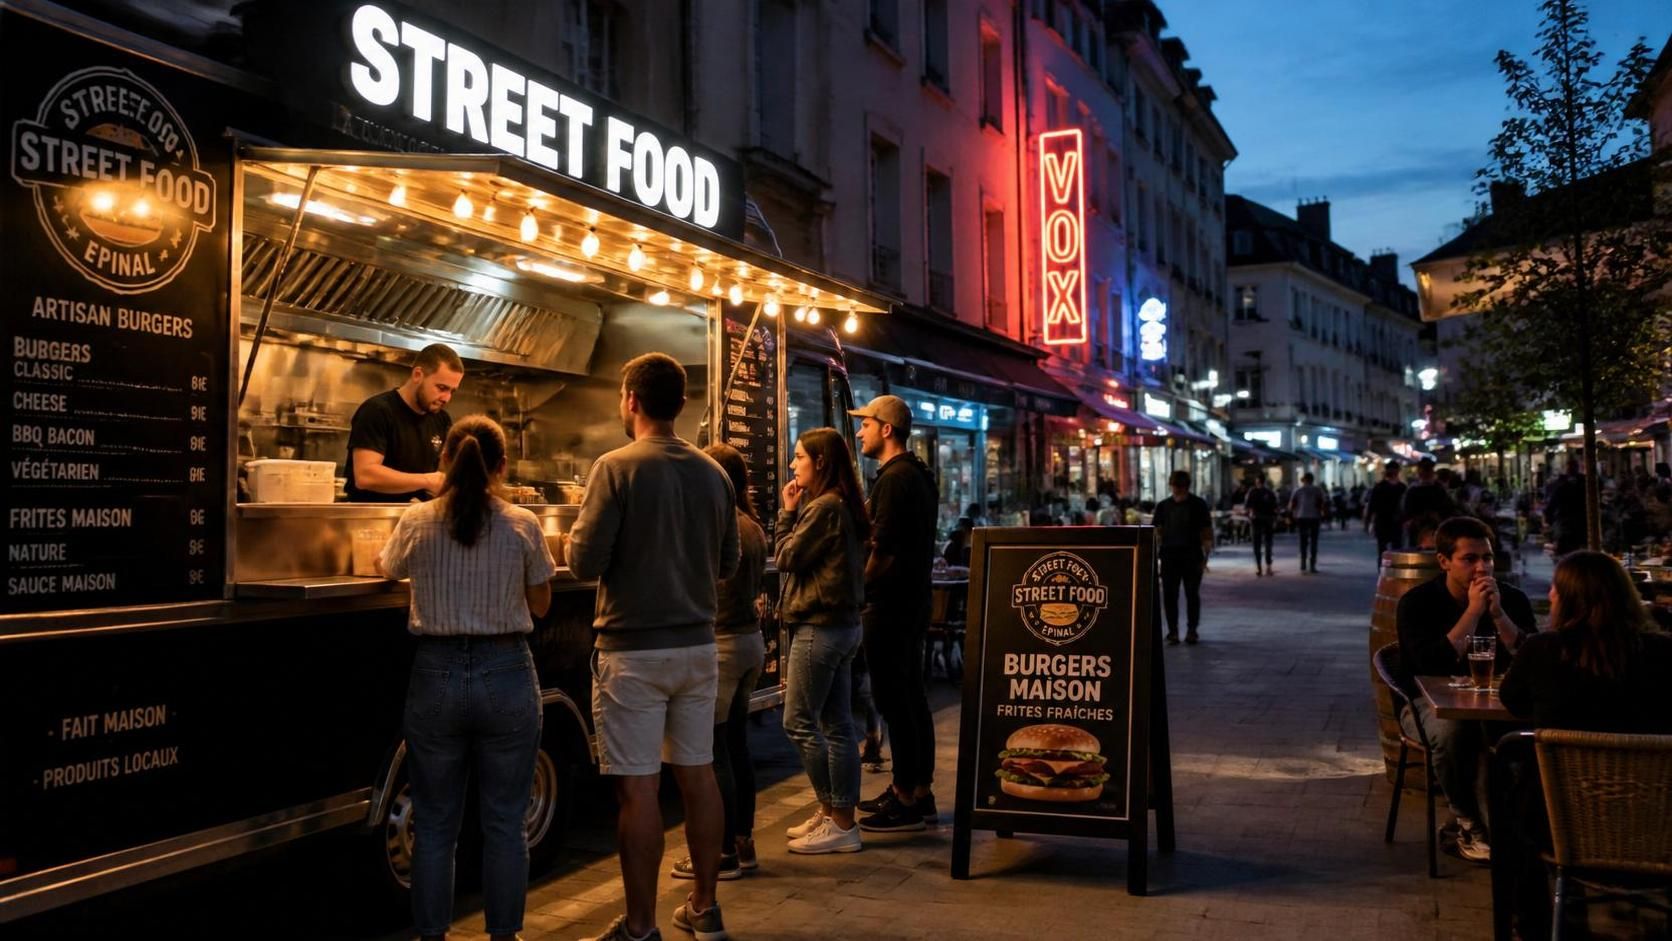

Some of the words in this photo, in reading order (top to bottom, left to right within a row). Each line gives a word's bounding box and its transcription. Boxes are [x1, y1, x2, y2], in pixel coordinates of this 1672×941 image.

[351, 4, 593, 179] STREET
[606, 116, 720, 229] FOOD
[20, 131, 132, 182] STREET
[140, 160, 210, 215] FOOD
[1044, 152, 1081, 324] VOX
[84, 240, 156, 277] EPINAL
[32, 296, 111, 327] ARTISAN
[117, 308, 194, 339] BURGERS
[14, 336, 92, 363] BURGERS
[14, 361, 74, 381] CLASSIC
[13, 391, 68, 412] CHEESE
[12, 424, 43, 448] BBQ
[48, 427, 95, 446] BACON
[11, 454, 100, 481] VÉGÉTARIEN
[10, 508, 67, 529] FRITES
[71, 508, 133, 528] MAISON
[9, 543, 67, 562] NATURE
[8, 575, 57, 596] SAUCE
[62, 572, 117, 593] MAISON
[1014, 586, 1066, 603] STREET
[1069, 586, 1106, 604] FOOD
[1004, 653, 1112, 678] BURGERS
[62, 715, 99, 741] FAIT
[104, 704, 167, 734] MAISON
[997, 704, 1043, 719] FRITES
[43, 756, 120, 790] PRODUITS
[124, 746, 179, 774] LOCAUX
